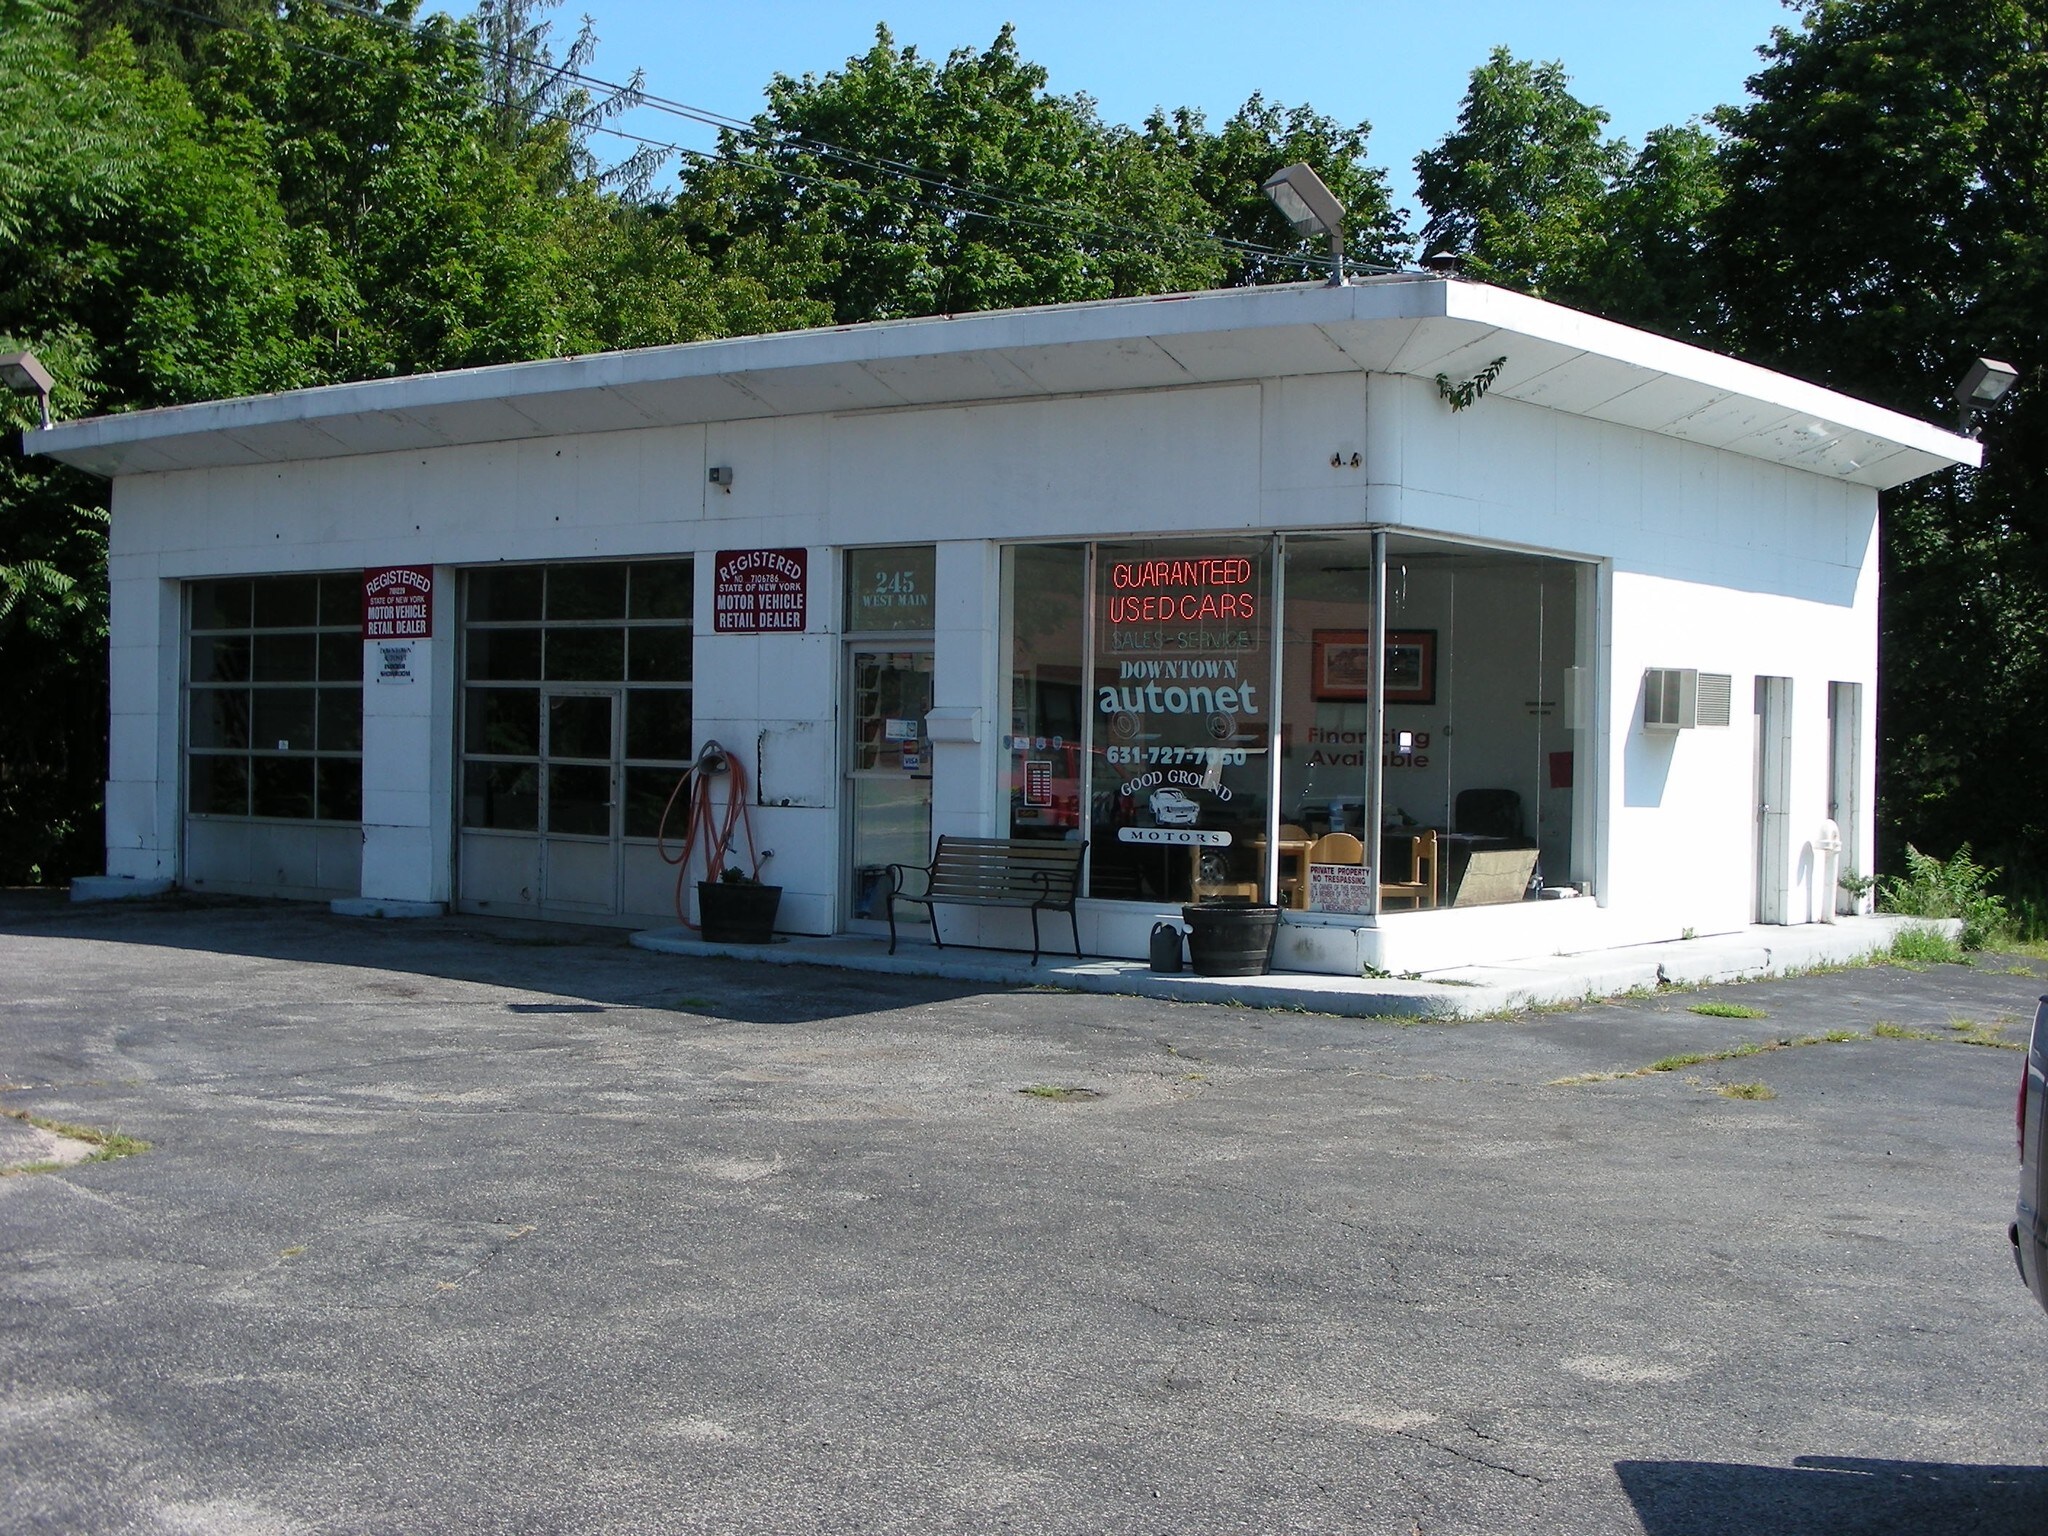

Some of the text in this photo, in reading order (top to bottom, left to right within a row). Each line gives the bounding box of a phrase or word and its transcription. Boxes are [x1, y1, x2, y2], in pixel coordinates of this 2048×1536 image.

[719, 551, 802, 582] REGISTERED
[1113, 559, 1251, 589] GUARANTEED
[366, 570, 431, 596] REGISTERED
[719, 582, 802, 592] STATE OF NEW YORK
[875, 571, 915, 594] 245
[370, 595, 425, 606] STATE OF NEW YORK
[717, 593, 804, 610] MOTOR VEHICLE
[862, 593, 929, 608] WEST MAIN
[1110, 593, 1255, 623] USED CARS
[368, 604, 428, 620] MOTOR VEHICLE
[719, 611, 801, 628] RETAIL DEALER
[368, 620, 427, 635] RETAIL DEALER
[1120, 659, 1238, 679] DOWNTOWN
[1099, 679, 1259, 715] autonet
[904, 757, 918, 765] VISA
[1121, 771, 1163, 796] GOOD
[1131, 831, 1220, 842] MOTORS
[1310, 866, 1370, 877] PRIVATE PROPERTY
[1312, 874, 1366, 885] NO TRESPASSING
